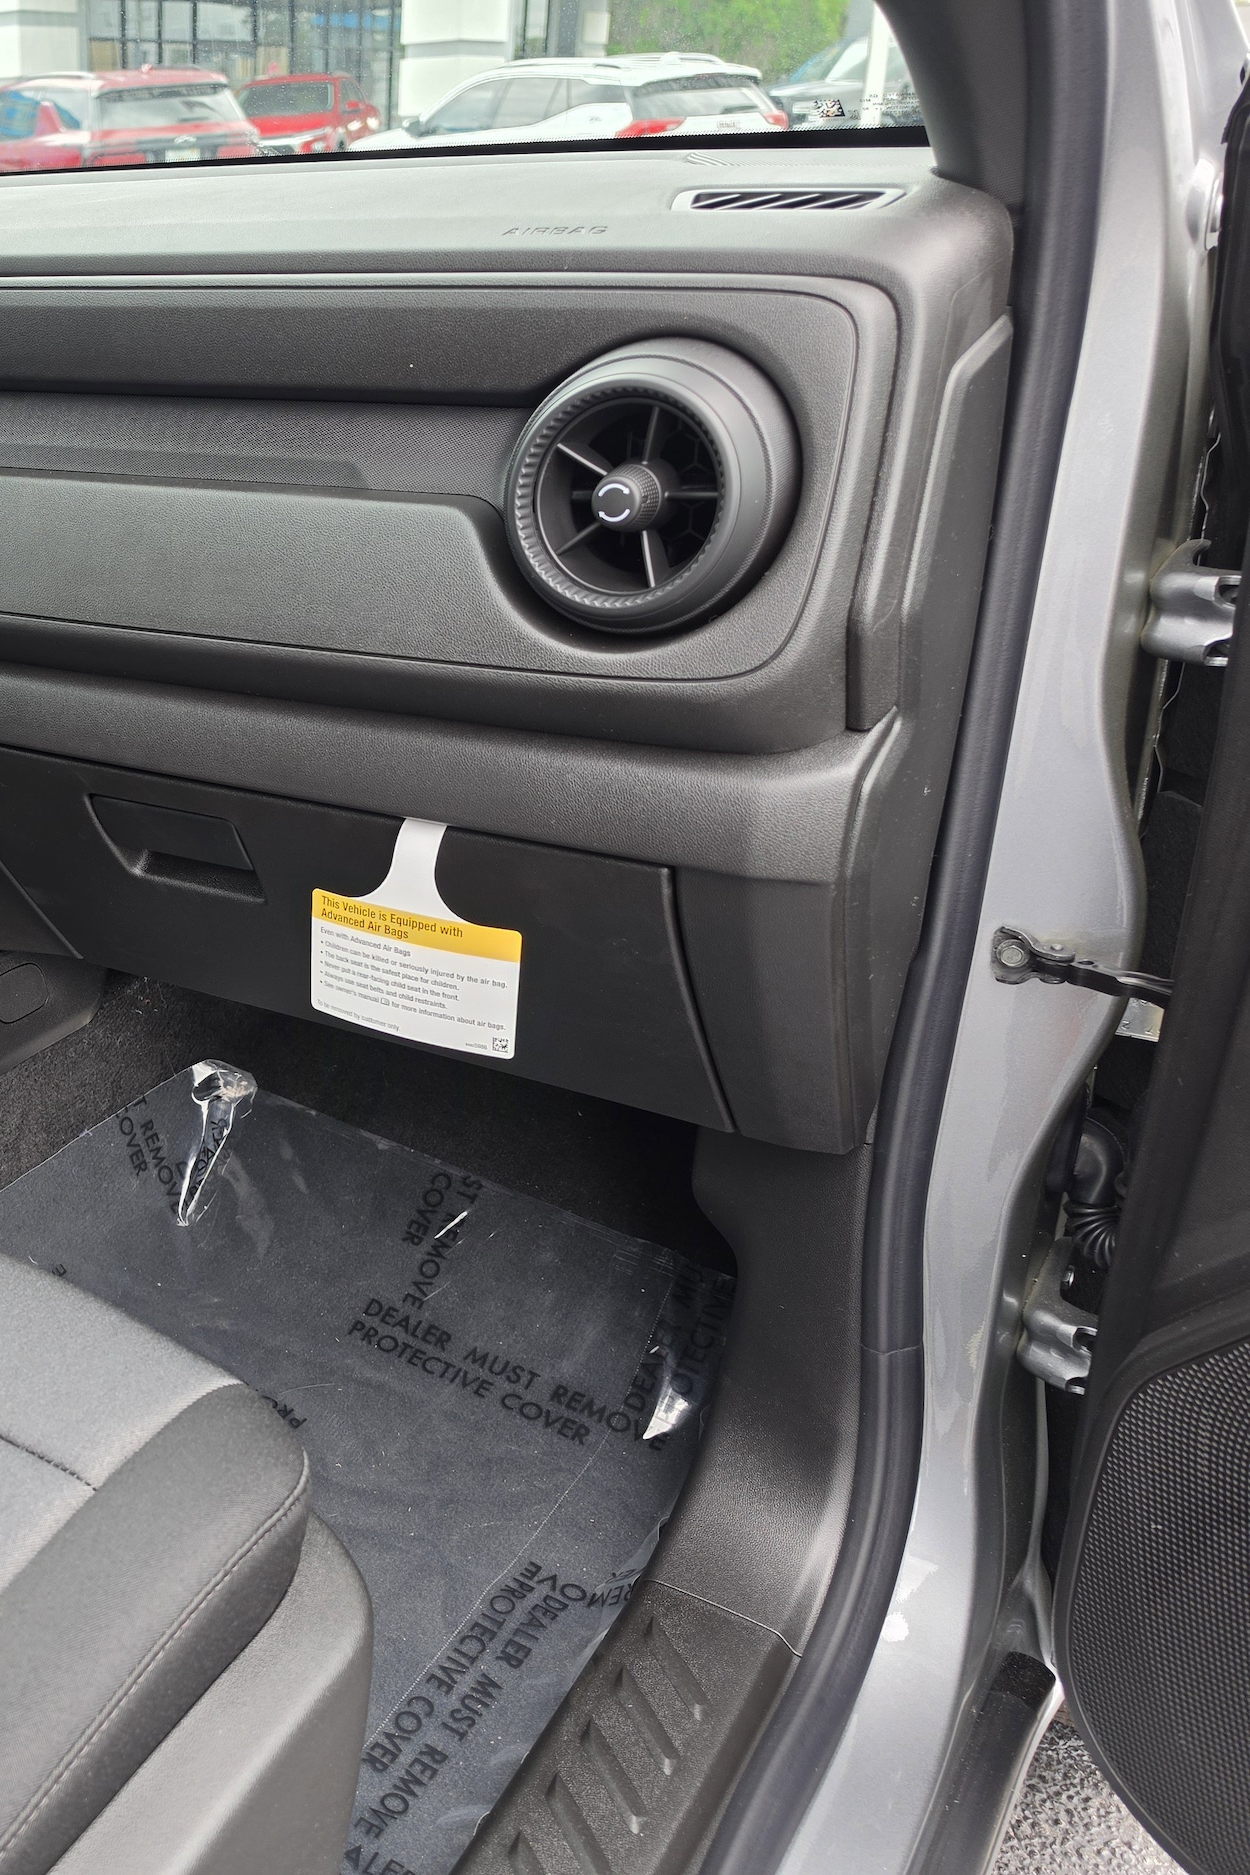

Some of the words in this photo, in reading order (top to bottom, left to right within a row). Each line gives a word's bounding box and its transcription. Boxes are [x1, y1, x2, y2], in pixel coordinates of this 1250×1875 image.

[501, 225, 608, 236] AIRBAG
[321, 908, 365, 928] Advanced
[367, 921, 381, 932] Air
[384, 925, 409, 940] Bags
[322, 895, 340, 909] This
[342, 901, 376, 919] Vehicle
[378, 910, 387, 922] is
[390, 913, 437, 931] Equipped
[440, 925, 463, 938] with
[320, 926, 334, 936] Even
[335, 931, 350, 941] with
[350, 935, 381, 949] Advanced
[382, 944, 393, 952] Air
[393, 946, 411, 957] Bags
[325, 940, 349, 953] Children
[350, 948, 362, 957] can
[362, 951, 370, 960] be
[371, 954, 389, 964] killed
[399, 961, 429, 974] seriously
[430, 968, 455, 979] injured
[456, 973, 465, 982] by
[466, 975, 479, 984] the
[480, 977, 491, 985] air
[492, 979, 508, 989] bag.
[324, 950, 335, 959] The
[335, 954, 349, 963] back
[350, 959, 363, 967] seat
[370, 964, 381, 972] the
[382, 967, 401, 978] safest
[401, 972, 419, 982] place
[420, 976, 429, 985] for
[430, 980, 460, 991] children.
[324, 960, 341, 971] Never
[341, 966, 351, 974] put
[357, 971, 390, 986] rear-facing
[390, 979, 406, 990] child
[407, 985, 421, 993] seat
[422, 987, 429, 995] in
[429, 989, 441, 998] the
[441, 992, 460, 1002] front.
[324, 970, 344, 982] Always
[345, 978, 355, 986] use
[356, 981, 369, 990] seat
[369, 985, 385, 995] belts
[385, 989, 398, 998] and
[398, 992, 414, 1002] child
[415, 997, 448, 1010] restraints.
[330, 1004, 353, 1017] removed
[353, 1010, 361, 1020] by
[361, 1016, 387, 1028] customer
[358, 993, 380, 1004] manual
[391, 1001, 400, 1009] for
[401, 1004, 417, 1013] more
[418, 1008, 456, 1022] information
[457, 1016, 476, 1026] about
[476, 1019, 487, 1028] air
[487, 1021, 507, 1031] bags.
[402, 1172, 452, 1247] COVER
[364, 1298, 454, 1352] DEALER
[464, 1346, 542, 1390] MUST
[347, 1319, 494, 1398] PROTECTIVE
[500, 1393, 594, 1447] COVER
[427, 1577, 535, 1695] PROTECTIVE
[496, 1594, 569, 1670] DEALER
[442, 1672, 503, 1742] MUST
[360, 1695, 436, 1775] COVER
[353, 1743, 449, 1839] REMOVE
